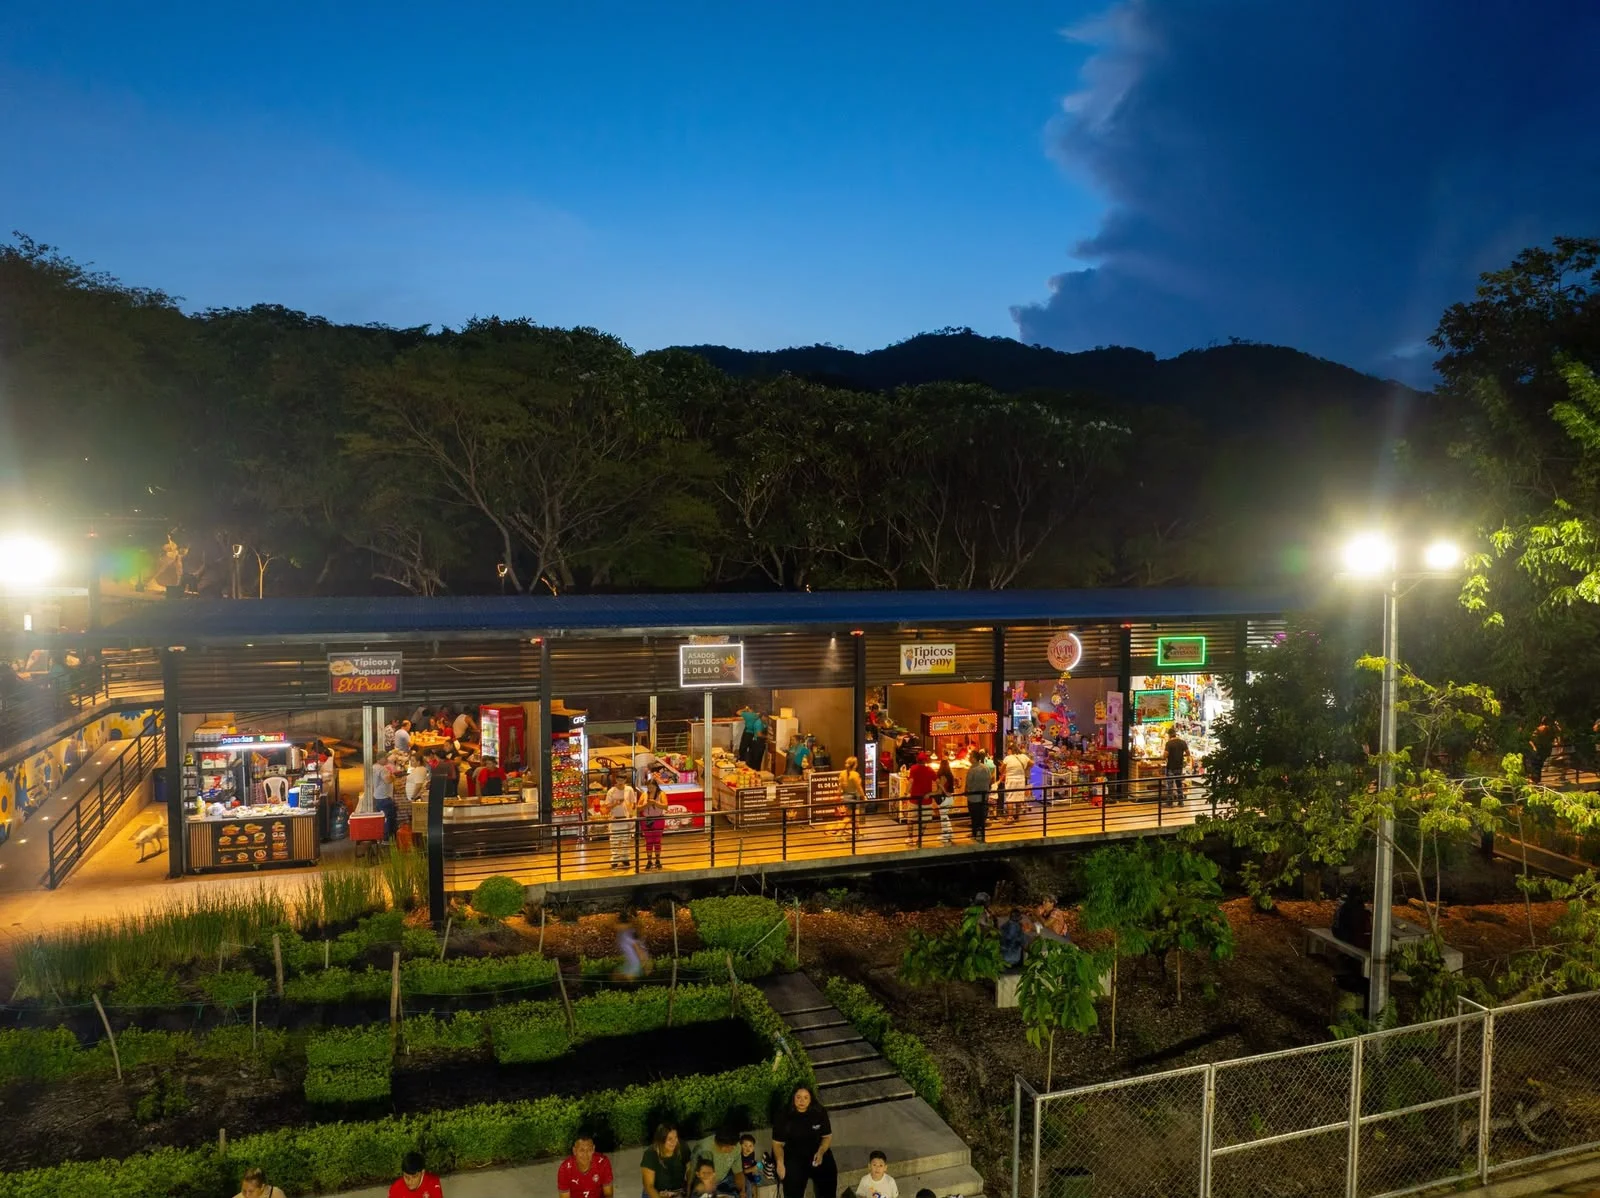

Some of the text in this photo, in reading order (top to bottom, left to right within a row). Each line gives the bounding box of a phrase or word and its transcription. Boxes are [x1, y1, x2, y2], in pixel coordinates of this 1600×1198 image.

[914, 657, 951, 669] Jeremy
[338, 676, 393, 693] El Prado
